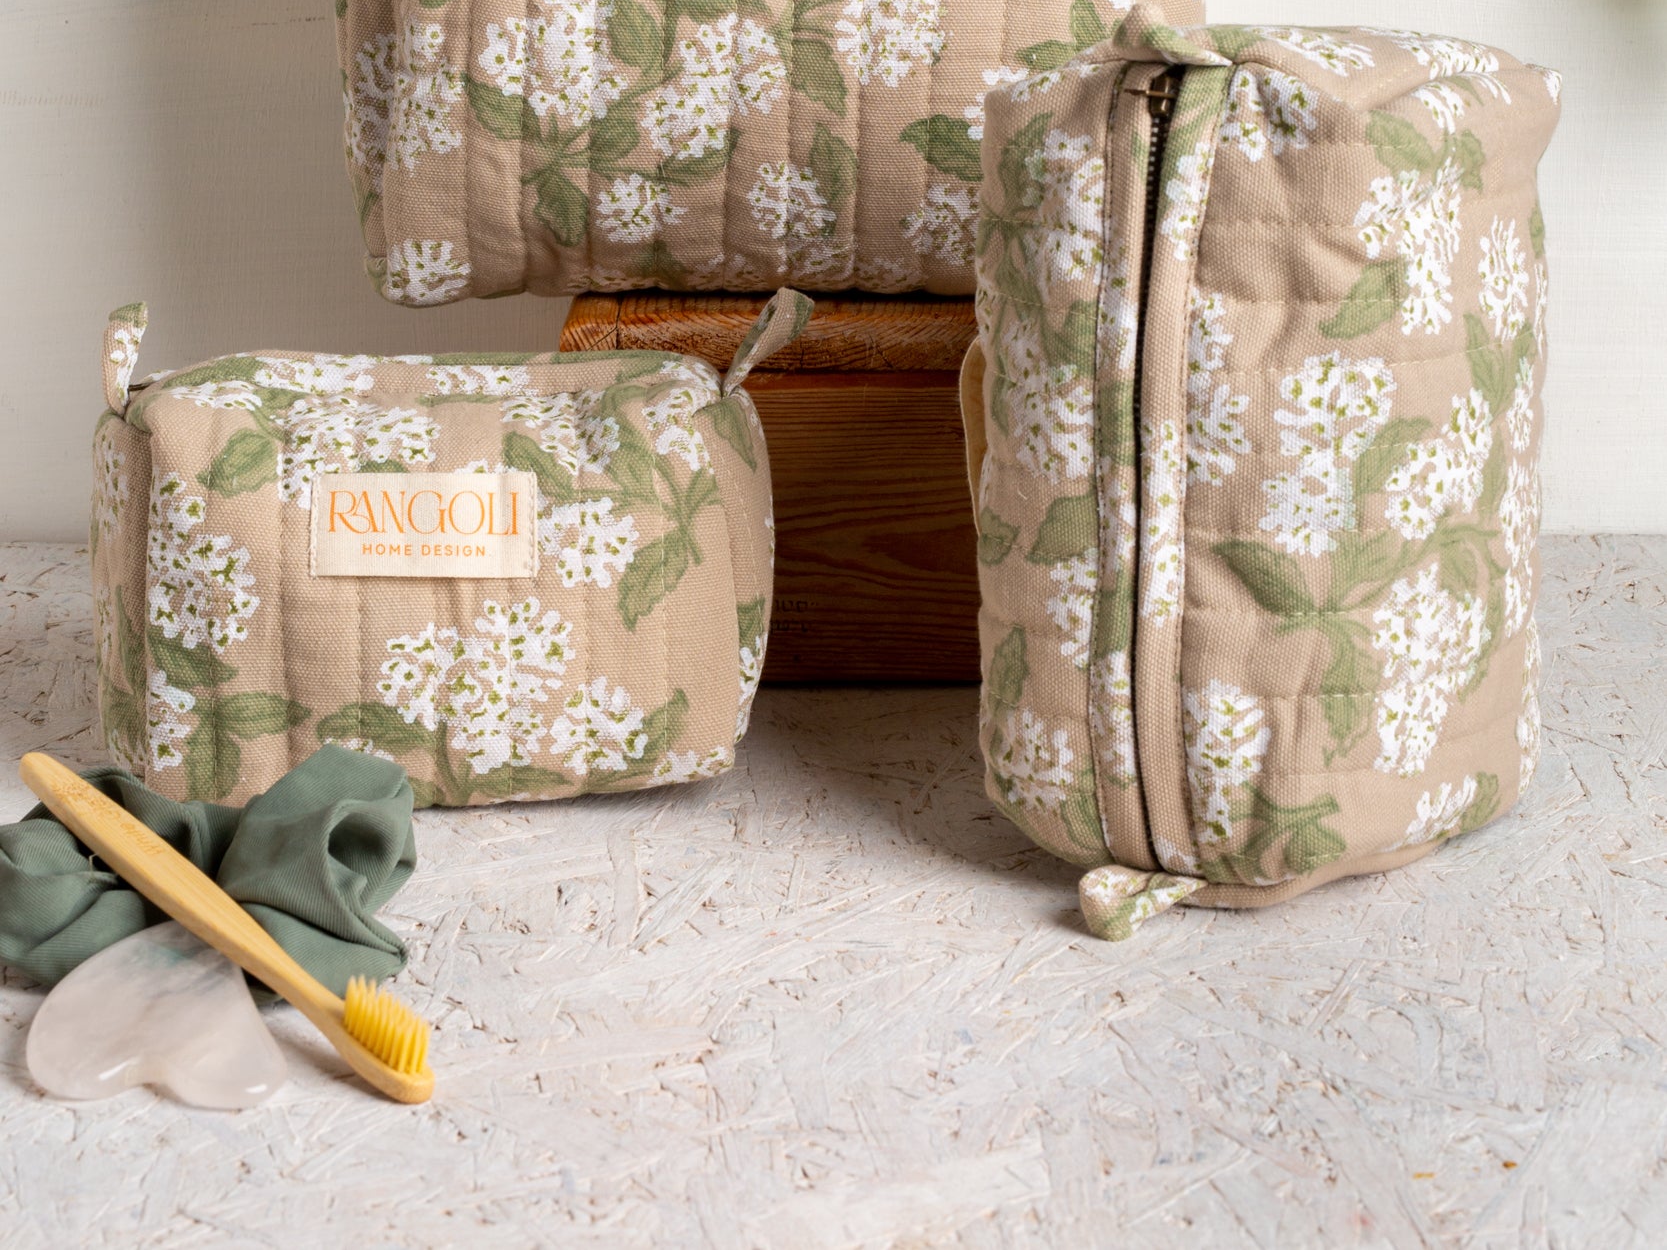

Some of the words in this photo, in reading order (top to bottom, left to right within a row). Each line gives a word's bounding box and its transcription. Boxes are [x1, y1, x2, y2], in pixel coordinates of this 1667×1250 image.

[328, 490, 519, 536] RANGOLI
[361, 543, 413, 556] HOME
[420, 544, 486, 557] DESIGN
